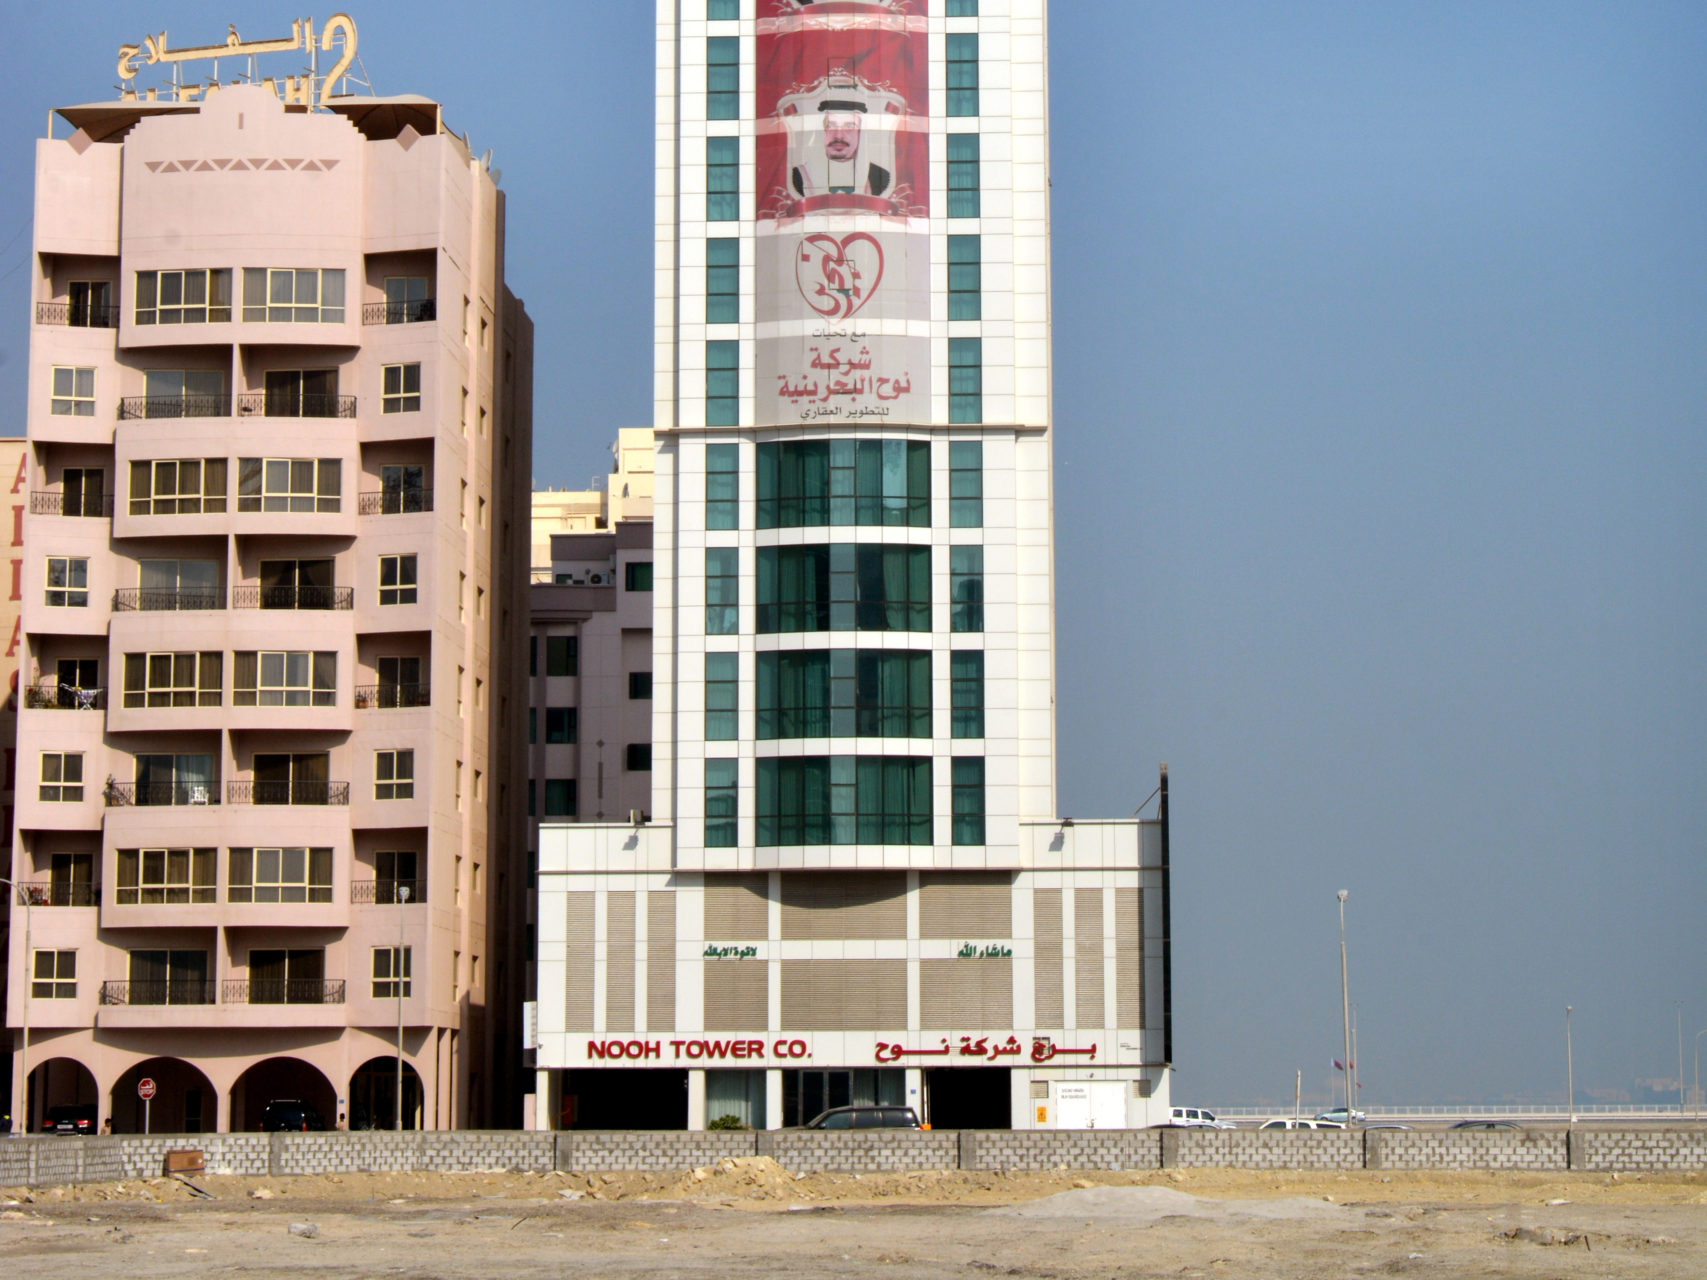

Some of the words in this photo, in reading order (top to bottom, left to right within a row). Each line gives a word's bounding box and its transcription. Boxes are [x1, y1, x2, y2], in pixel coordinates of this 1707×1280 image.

[812, 328, 847, 340] تحيات
[850, 331, 867, 343] مع
[809, 346, 872, 376] شركة
[777, 374, 873, 404] البحرينية
[876, 371, 911, 400] نوح
[800, 406, 842, 420] العقاري
[846, 406, 890, 419] للتطوير
[957, 941, 977, 958] الله
[587, 1040, 661, 1059] NOOH
[670, 1040, 765, 1059] TOWER
[773, 1039, 813, 1058] CO.
[875, 1037, 951, 1062] نوح
[959, 1035, 1022, 1060] شركة
[1031, 1040, 1097, 1062] برج
